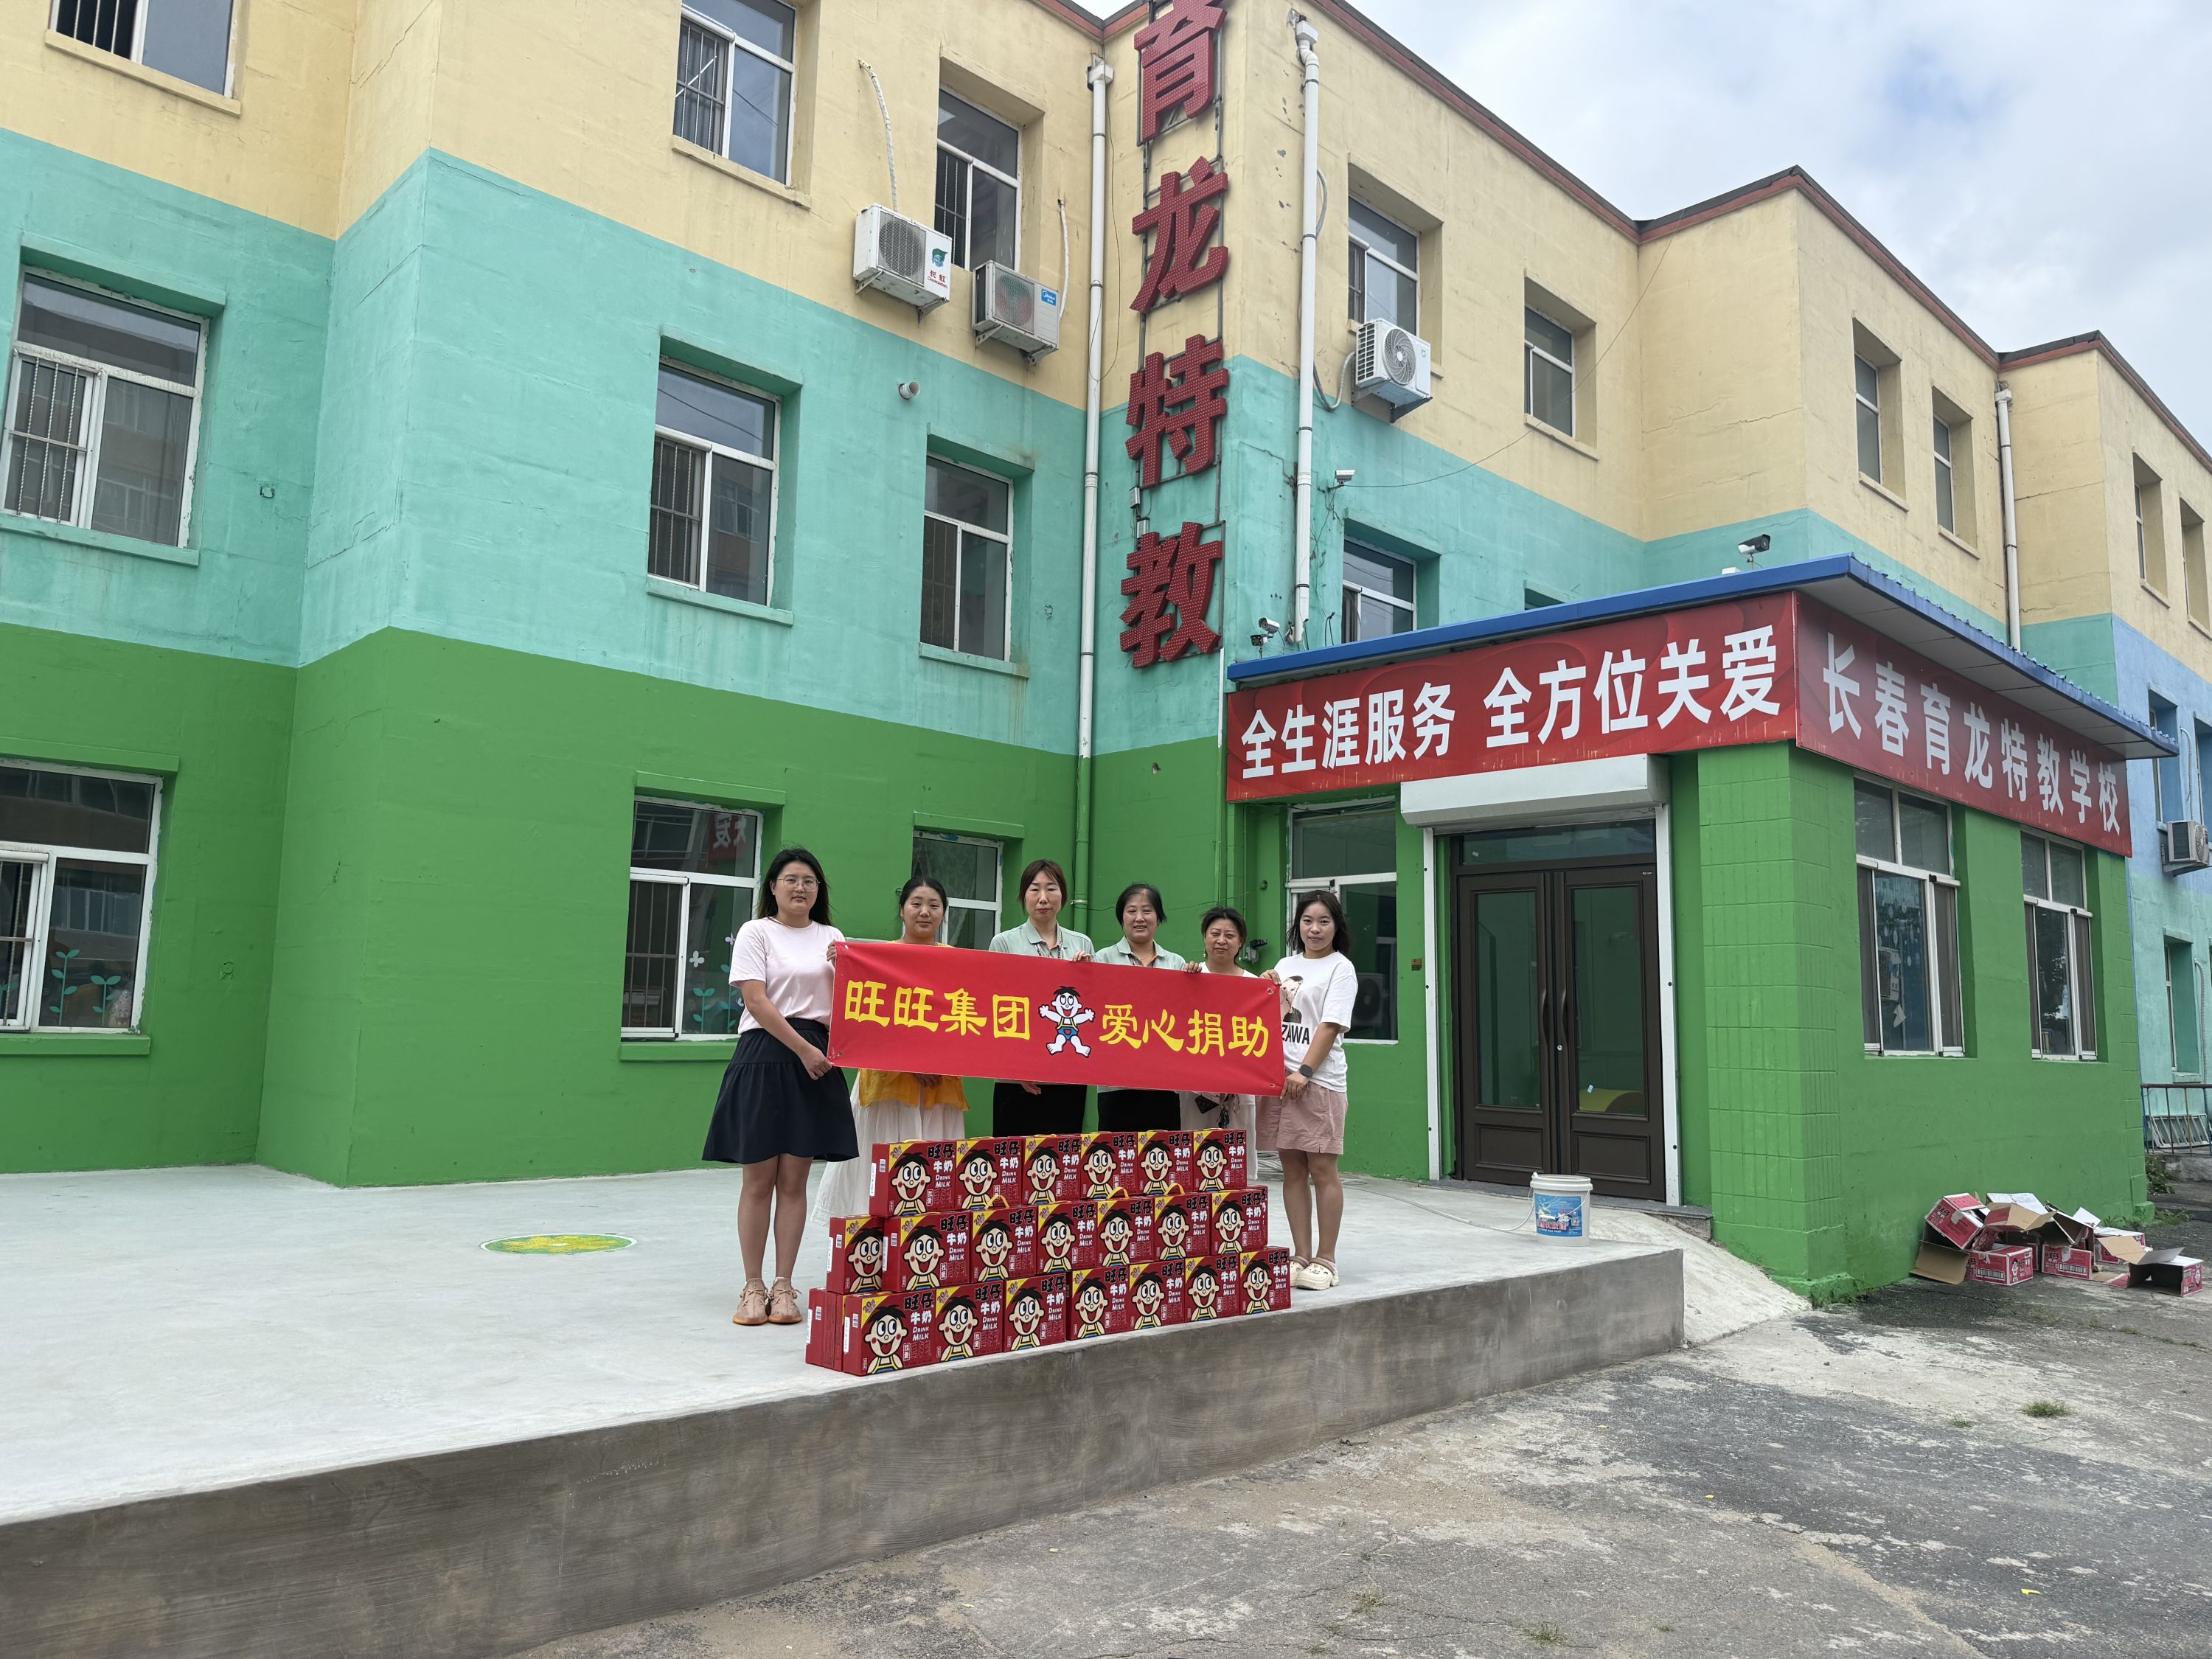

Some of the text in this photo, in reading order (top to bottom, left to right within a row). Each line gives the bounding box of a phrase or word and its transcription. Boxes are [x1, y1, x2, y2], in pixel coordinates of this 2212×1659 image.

[930, 270, 945, 283] 长虹
[1119, 0, 1230, 671] 育龙特教
[1241, 624, 1781, 779] 全生涯服务 全方位关爱
[1823, 632, 2121, 836] 长春育龙特教学校
[844, 979, 1270, 1058] 旺旺集团 爱心捐助
[1113, 1134, 1135, 1148] 旺仔
[1169, 1133, 1191, 1147] 旺仔
[1225, 1132, 1245, 1144] 旺仔
[928, 1143, 954, 1158] 旺仔
[994, 1141, 1020, 1155] 旺仔
[1058, 1138, 1080, 1153] 旺仔
[1175, 1147, 1190, 1158] 牛奶
[1229, 1146, 1245, 1156] 牛奶
[1062, 1154, 1079, 1166] 牛奶
[1119, 1149, 1135, 1161] 牛奶
[933, 1160, 953, 1173] 牛奶
[1000, 1157, 1018, 1169] 牛奶
[1186, 1195, 1208, 1209] 旺仔
[1242, 1192, 1261, 1206] 旺仔
[1072, 1204, 1095, 1219] 旺仔
[1130, 1200, 1152, 1214] 旺仔
[1246, 1207, 1261, 1218] 牛奶
[940, 1215, 968, 1231] 旺仔
[1009, 1209, 1034, 1225] 旺仔
[1135, 1215, 1152, 1228] 牛奶
[1192, 1211, 1207, 1222] 牛奶
[1015, 1225, 1033, 1238] 牛奶
[1077, 1220, 1094, 1232] 牛奶
[947, 1232, 967, 1245] 牛奶
[1216, 1255, 1237, 1270] 旺仔
[1269, 1250, 1288, 1265] 旺仔
[1105, 1267, 1127, 1283] 旺仔
[1161, 1262, 1184, 1276] 旺仔
[1221, 1270, 1237, 1282] 牛奶
[1273, 1265, 1287, 1276] 牛奶
[1041, 1276, 1065, 1292] 旺仔
[1110, 1283, 1127, 1296] 牛奶
[1166, 1277, 1183, 1289] 牛奶
[975, 1284, 1001, 1301] 旺仔
[1047, 1293, 1064, 1306] 牛奶
[904, 1292, 933, 1310] 旺仔
[981, 1301, 1000, 1315] 牛奶
[911, 1310, 932, 1325] 牛奶
[983, 1323, 997, 1331] MILK
[913, 1333, 928, 1341] MILK
